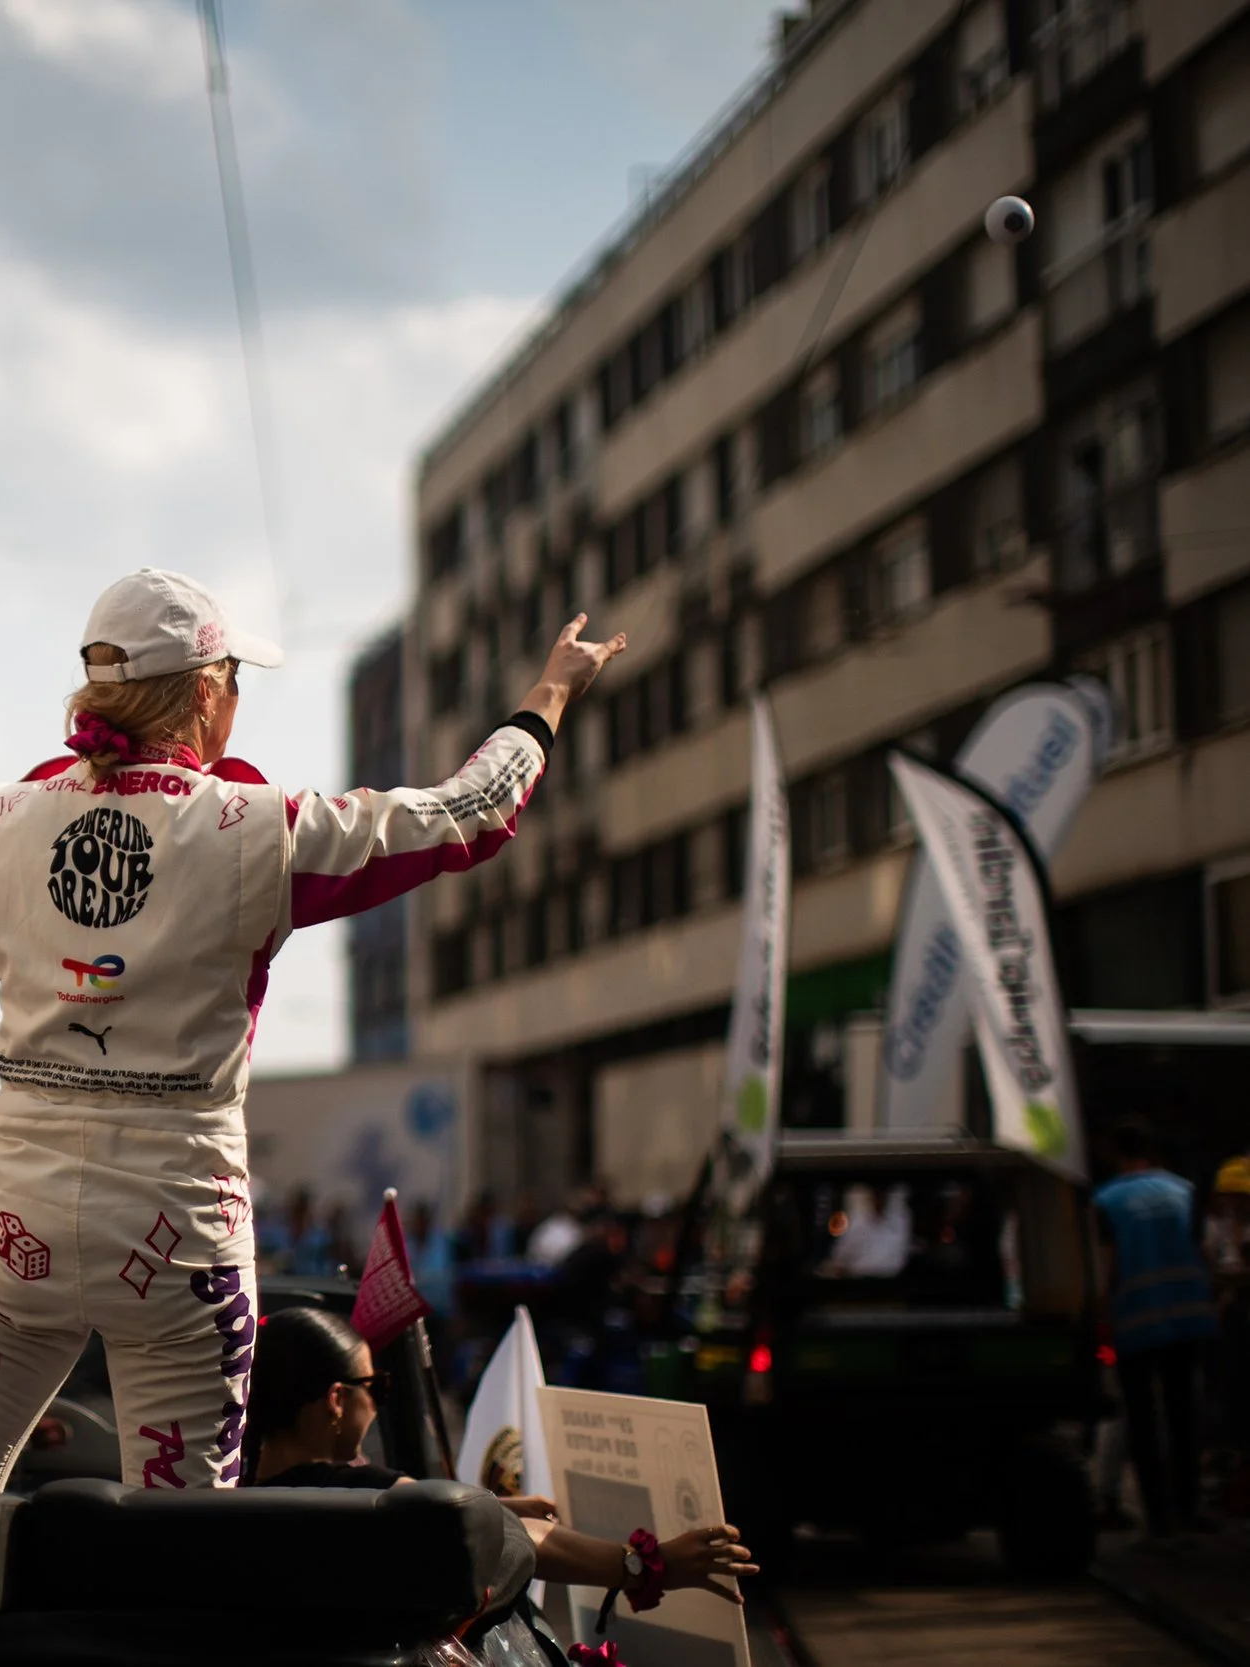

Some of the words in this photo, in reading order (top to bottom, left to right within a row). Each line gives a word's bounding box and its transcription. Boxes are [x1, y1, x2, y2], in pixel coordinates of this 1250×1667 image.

[39, 776, 86, 793] TOTAL
[91, 770, 196, 797] ENERGY
[53, 808, 154, 852] POWERING
[50, 834, 154, 898] YOUR
[47, 868, 149, 929] DREAMS
[56, 991, 126, 1005] TotalEnergies
